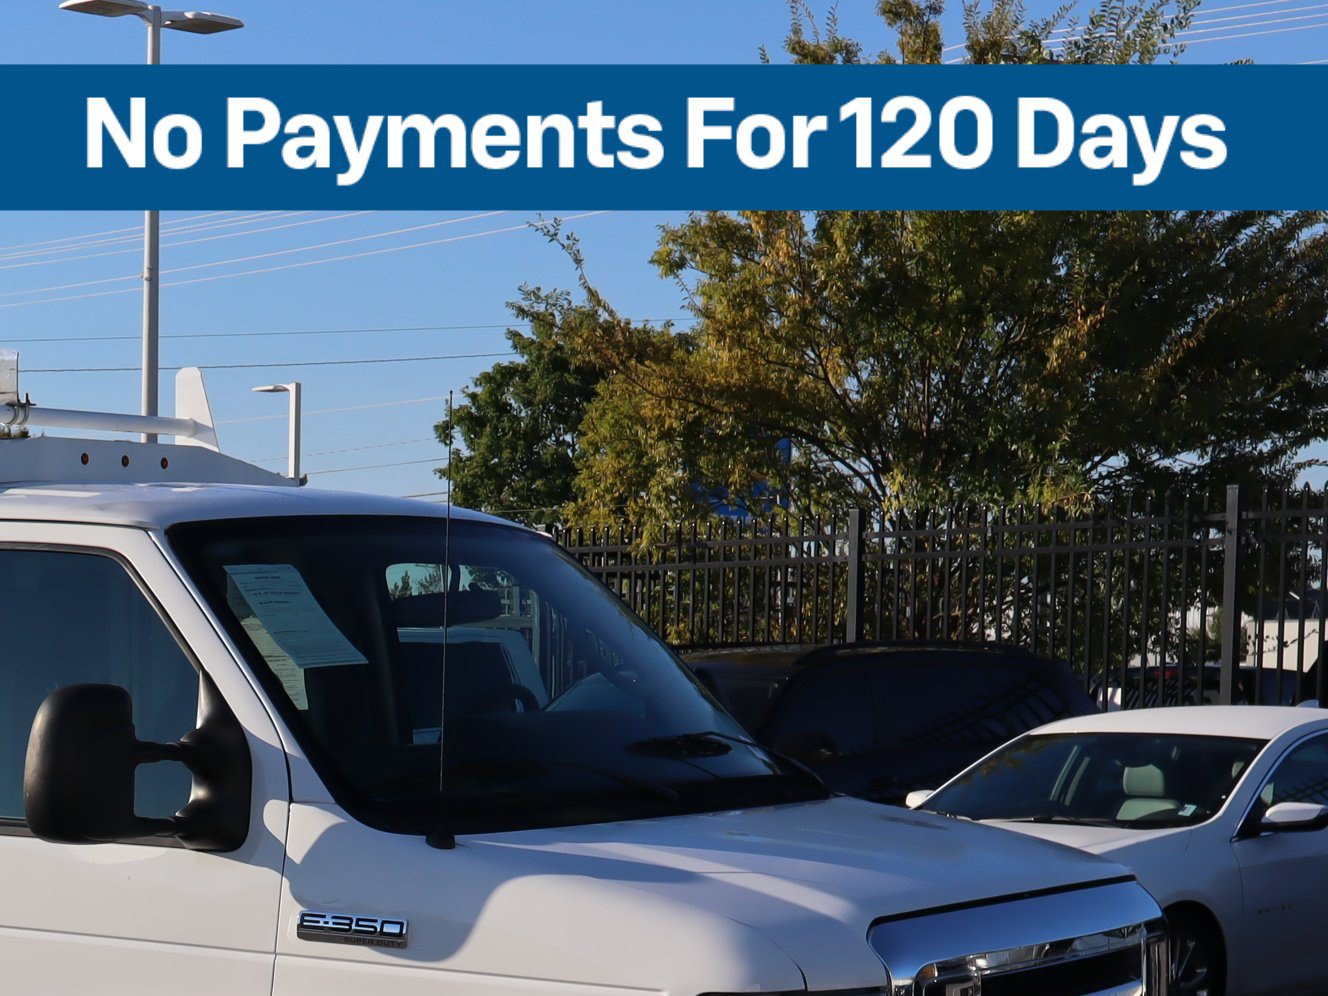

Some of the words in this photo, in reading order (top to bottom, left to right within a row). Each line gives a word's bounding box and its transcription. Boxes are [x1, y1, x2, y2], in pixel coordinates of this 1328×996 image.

[299, 912, 405, 937] E-350
[344, 937, 374, 946] SUPER
[377, 939, 402, 948] DUTY
